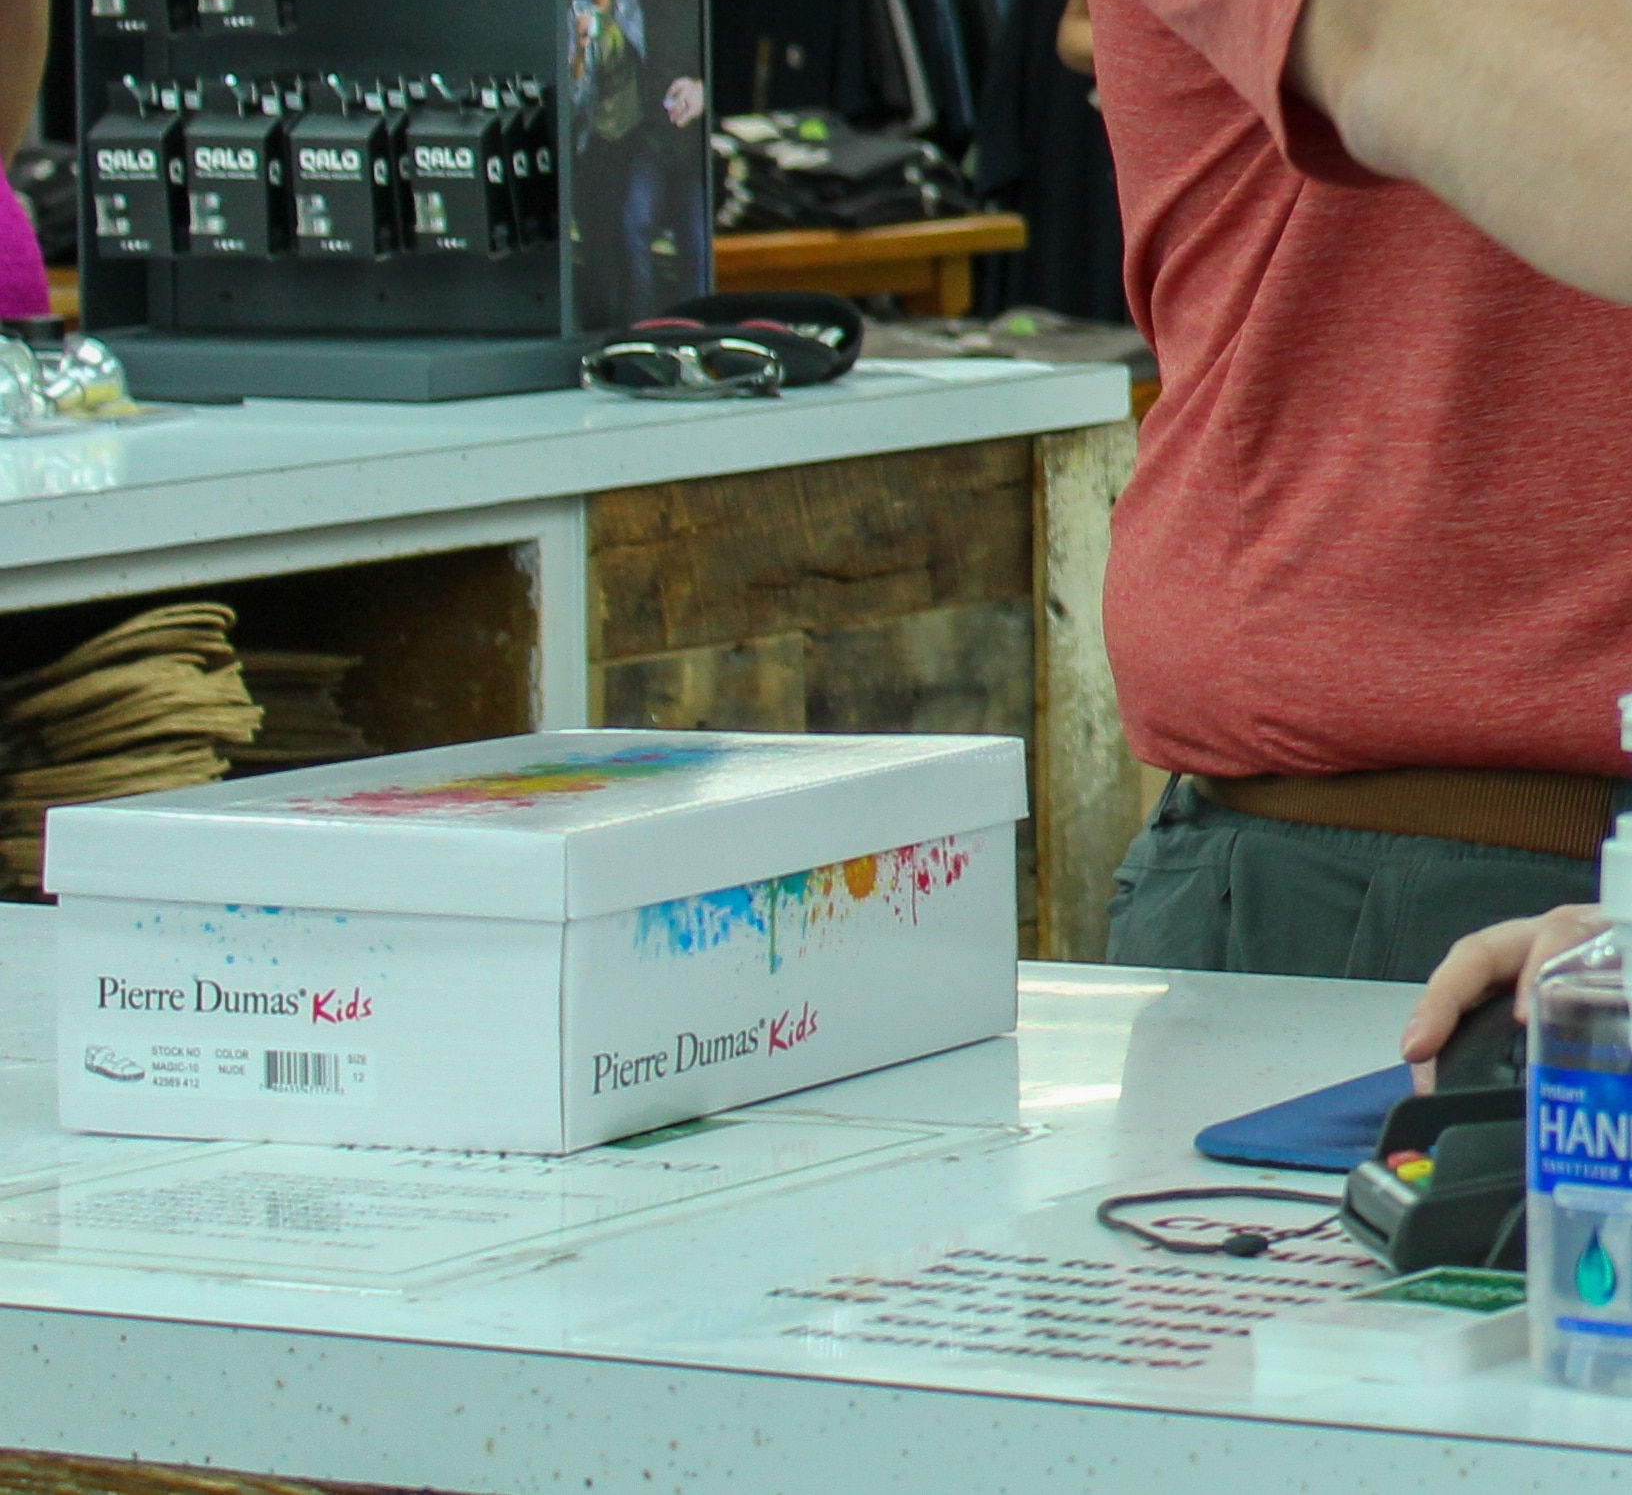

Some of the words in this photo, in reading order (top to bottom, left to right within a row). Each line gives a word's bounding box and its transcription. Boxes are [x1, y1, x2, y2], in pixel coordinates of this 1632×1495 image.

[97, 149, 158, 174] QALO
[194, 147, 258, 172] QALO
[299, 148, 362, 173] QALO
[414, 146, 475, 169] QALO
[98, 976, 184, 1010] Pierre
[194, 979, 299, 1016] Dumas
[312, 987, 371, 1024] Kids
[152, 1047, 185, 1058] STOCK
[215, 1049, 249, 1059] COLOR
[593, 1052, 668, 1094] Pierre
[674, 1026, 759, 1074] Dumas
[768, 1001, 818, 1056] Kids
[218, 1065, 245, 1075] NUDE
